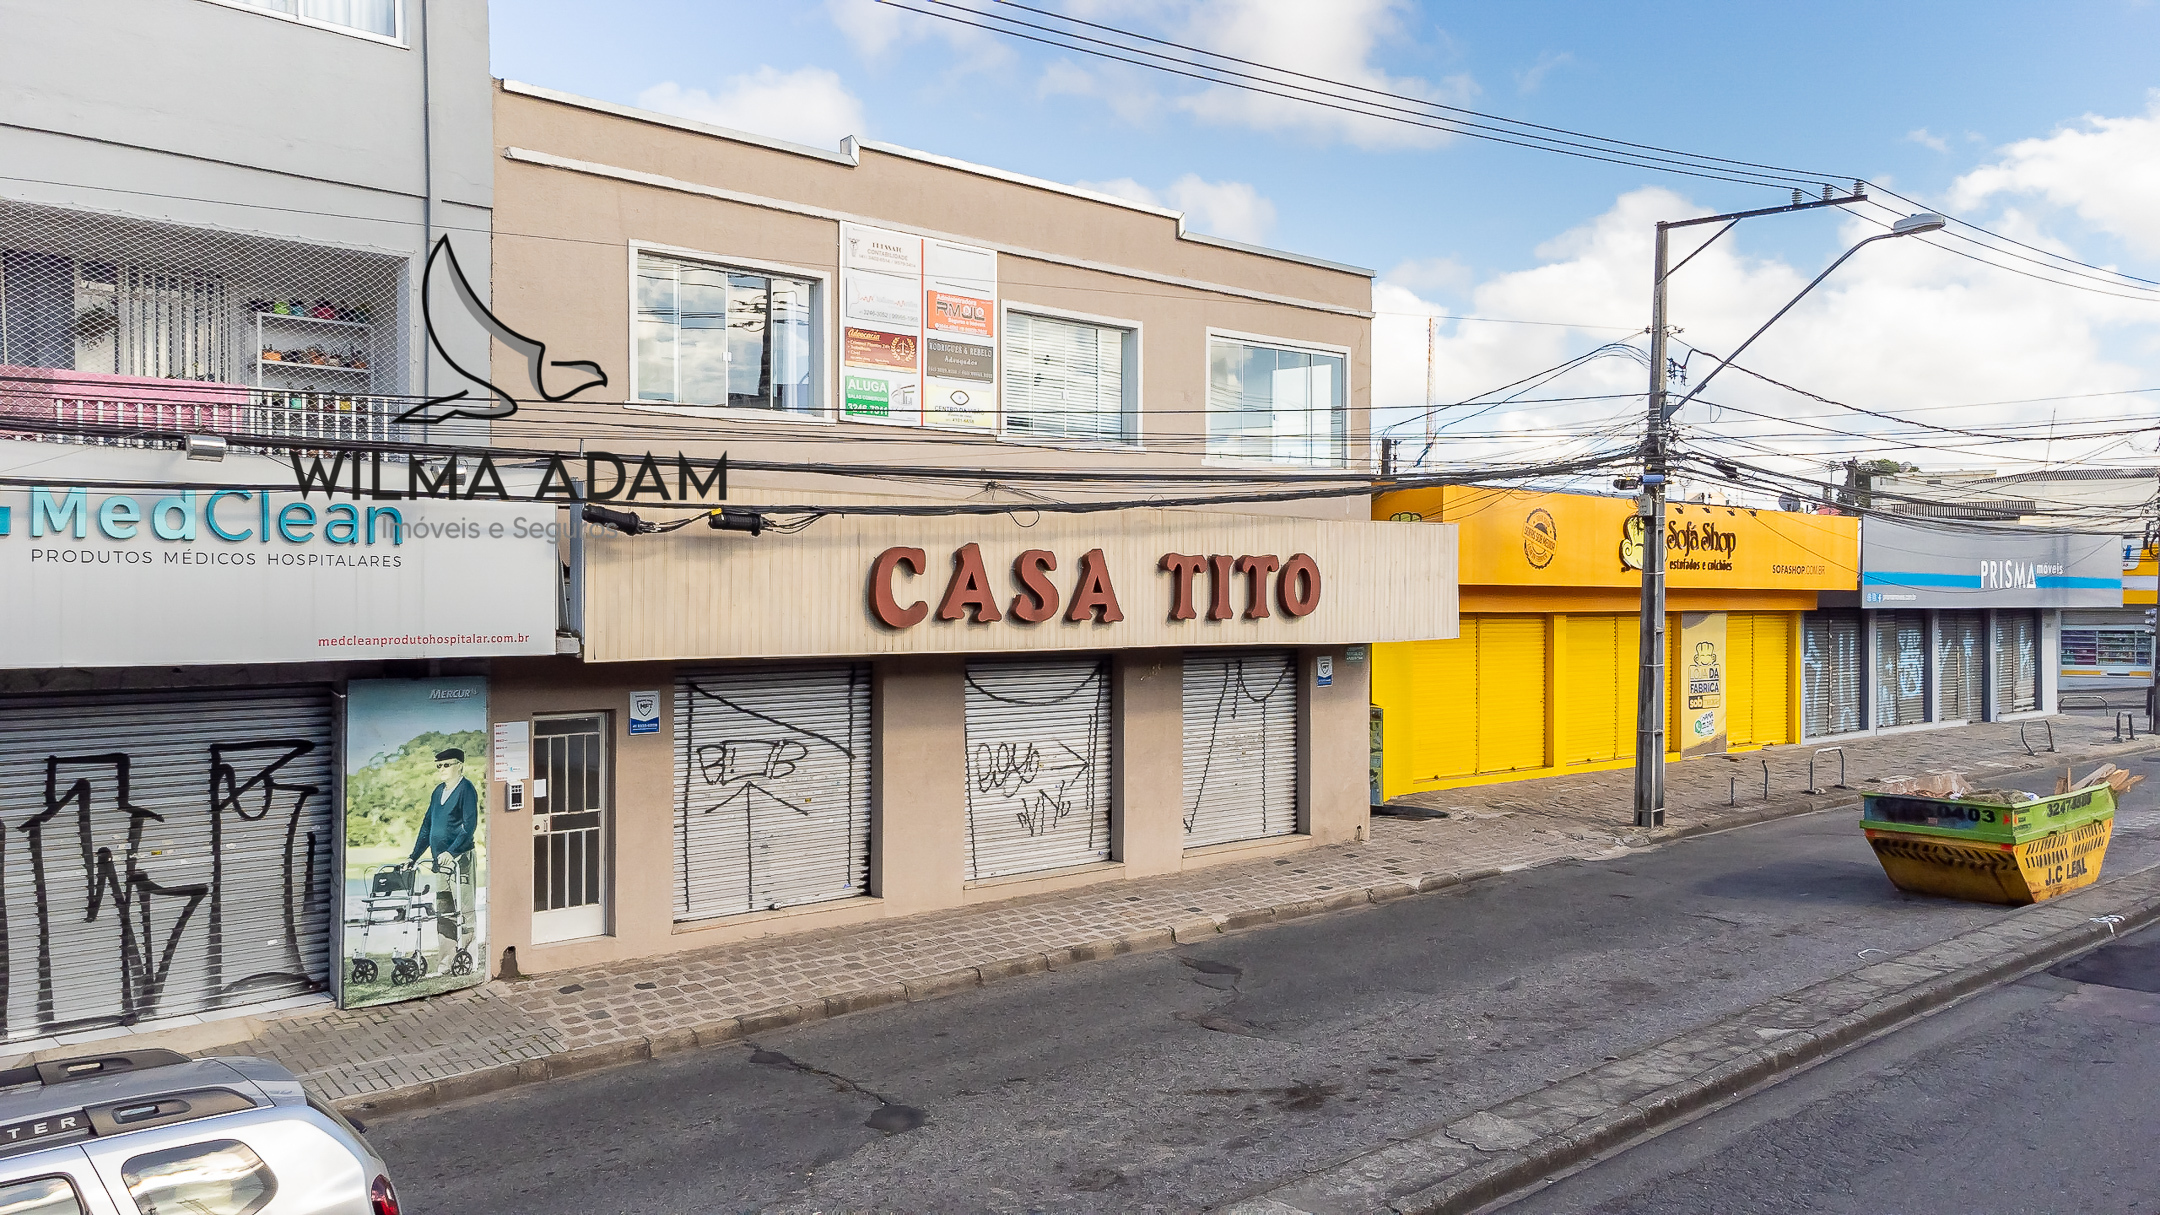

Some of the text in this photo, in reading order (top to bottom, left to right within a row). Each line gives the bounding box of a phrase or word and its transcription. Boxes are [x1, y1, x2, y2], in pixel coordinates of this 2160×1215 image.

[929, 342, 962, 354] RODRIGUES
[970, 348, 992, 358] REBELO
[848, 379, 887, 393] ALUGA
[30, 486, 404, 546] MedClean
[1667, 520, 1737, 560] Sofá Shop
[31, 548, 402, 568] PRODUTOS MÉDICOS HOSPITALARES
[1772, 564, 1826, 576] SOFASHOP.COM.BR
[1980, 559, 2064, 589] PRISMA móveis
[870, 543, 1321, 629] CASA TITO
[318, 633, 530, 648] medcleanprodutohospitalar.com.br
[1709, 667, 1719, 679] DA
[428, 689, 471, 699] MERCUR
[2045, 865, 2063, 886] J.C
[7, 1116, 77, 1139] TER
